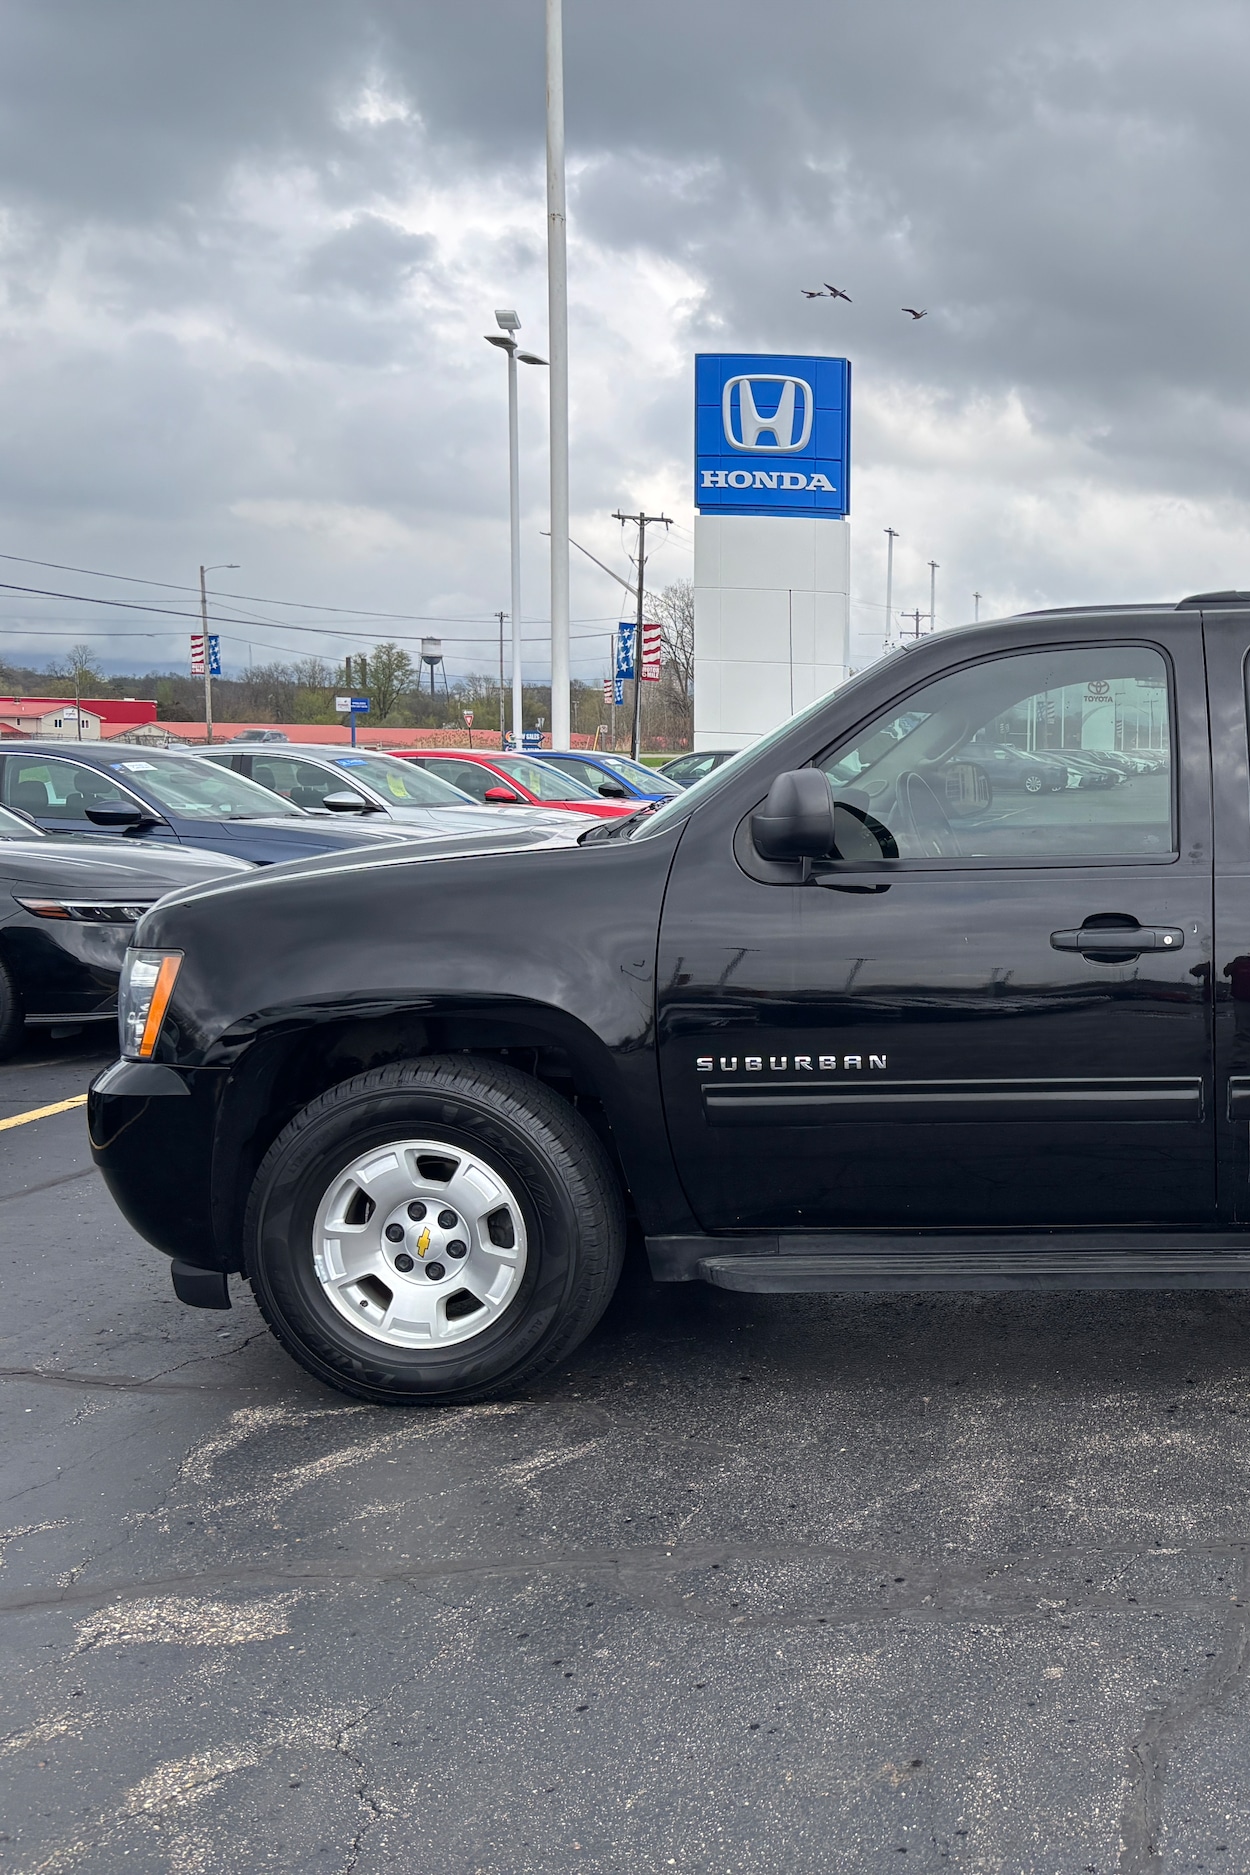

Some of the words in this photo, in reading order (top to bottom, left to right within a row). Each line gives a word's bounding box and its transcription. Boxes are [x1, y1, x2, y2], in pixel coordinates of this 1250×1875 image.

[700, 470, 837, 492] HONDA
[1083, 695, 1113, 703] TOYOTA
[696, 1055, 887, 1071] SUBURBAN
